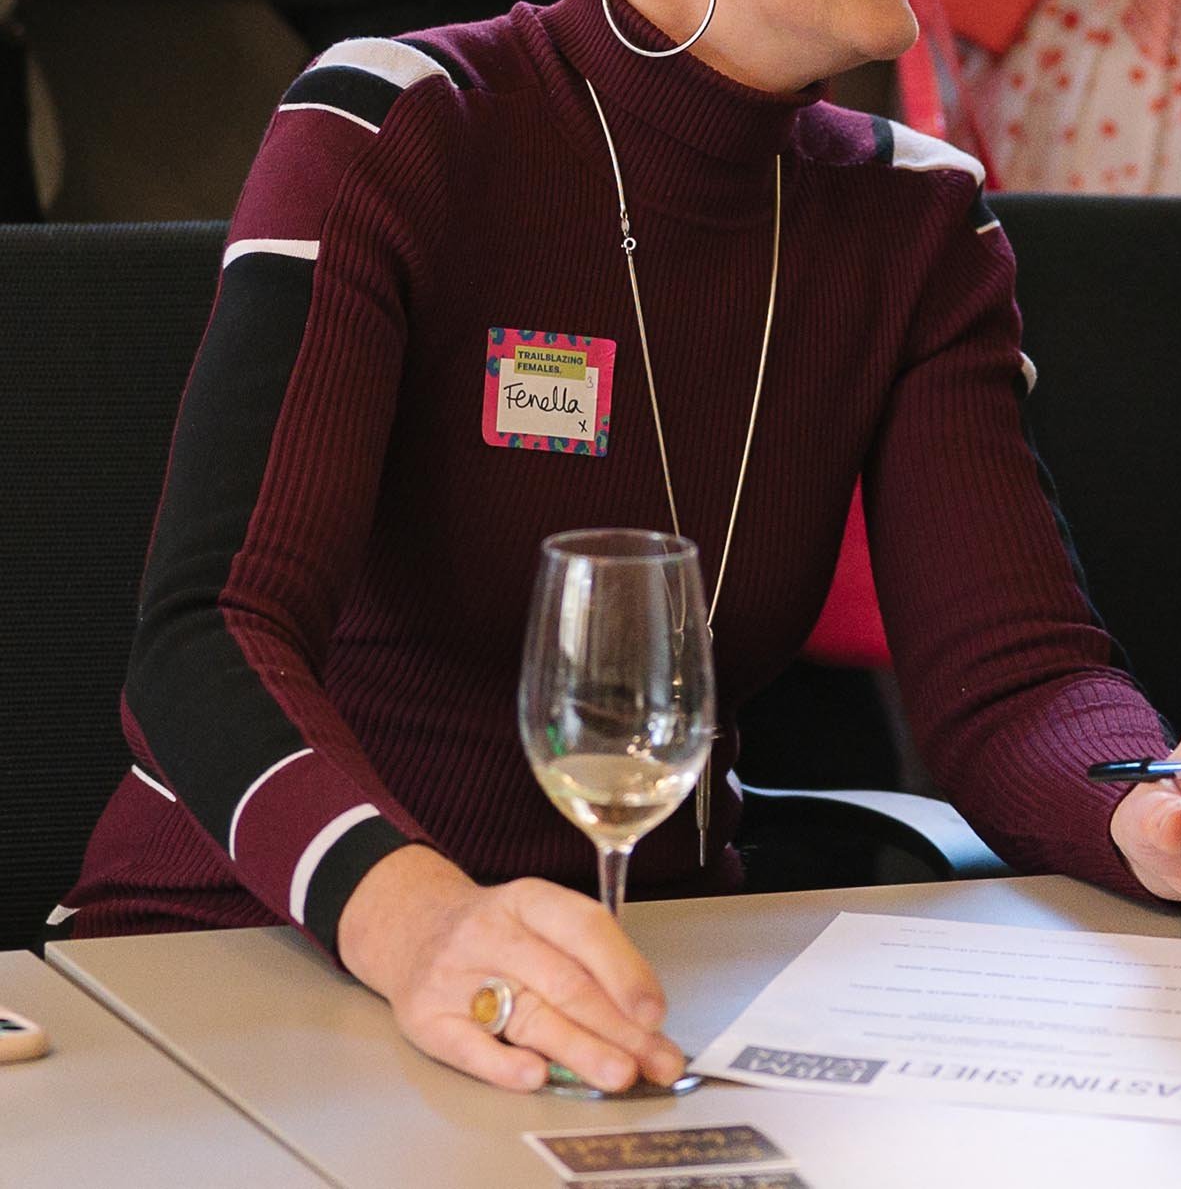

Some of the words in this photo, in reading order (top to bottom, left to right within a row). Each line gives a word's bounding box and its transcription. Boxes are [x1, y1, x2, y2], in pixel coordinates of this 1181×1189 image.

[518, 350, 584, 365] TRAILBLAZING
[503, 382, 584, 414] Fenella
[892, 1060, 1023, 1085] SHEET
